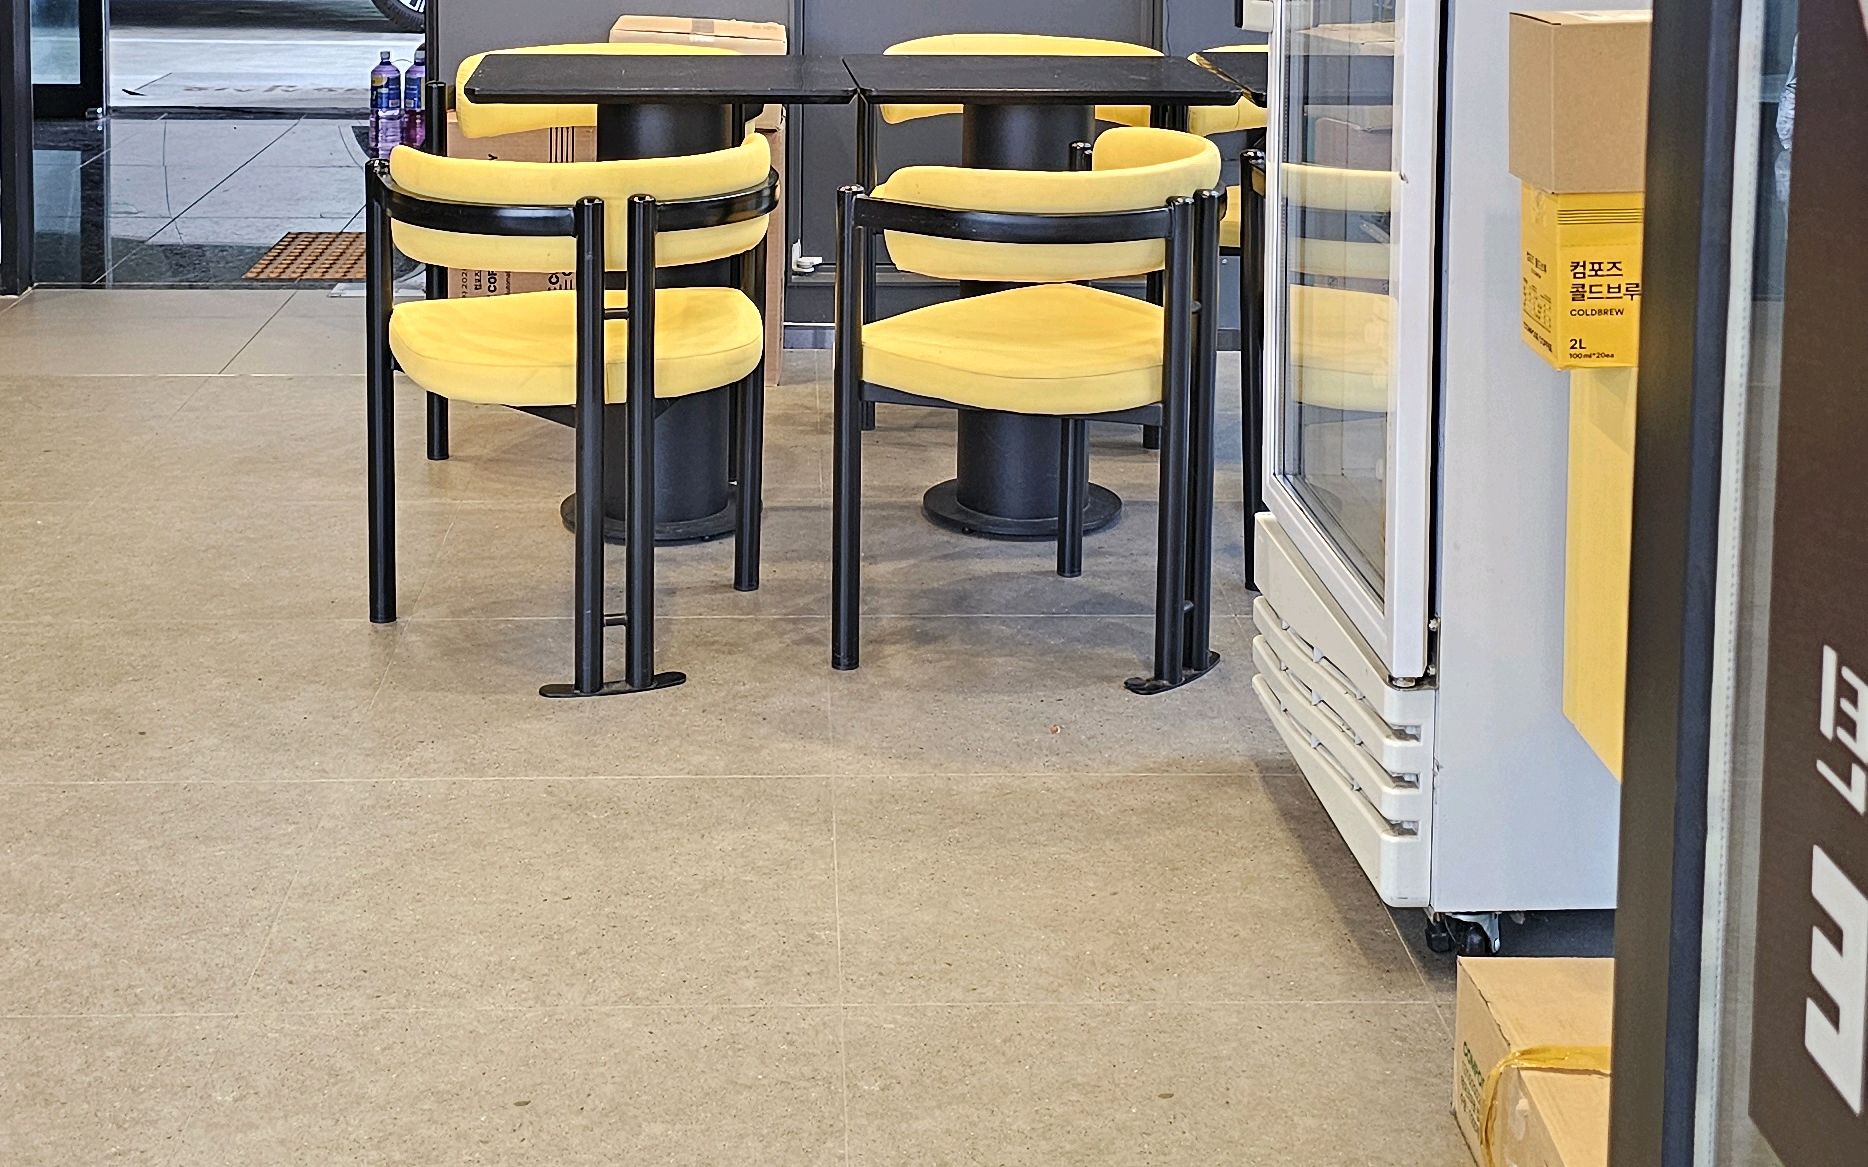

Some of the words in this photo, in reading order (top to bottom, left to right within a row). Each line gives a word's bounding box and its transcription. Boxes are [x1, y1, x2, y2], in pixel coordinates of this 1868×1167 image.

[1569, 260, 1624, 280] 컴포즈
[1569, 282, 1642, 302] 콜드브루
[1569, 308, 1625, 317] COLDBREW
[1569, 338, 1587, 350] 2L
